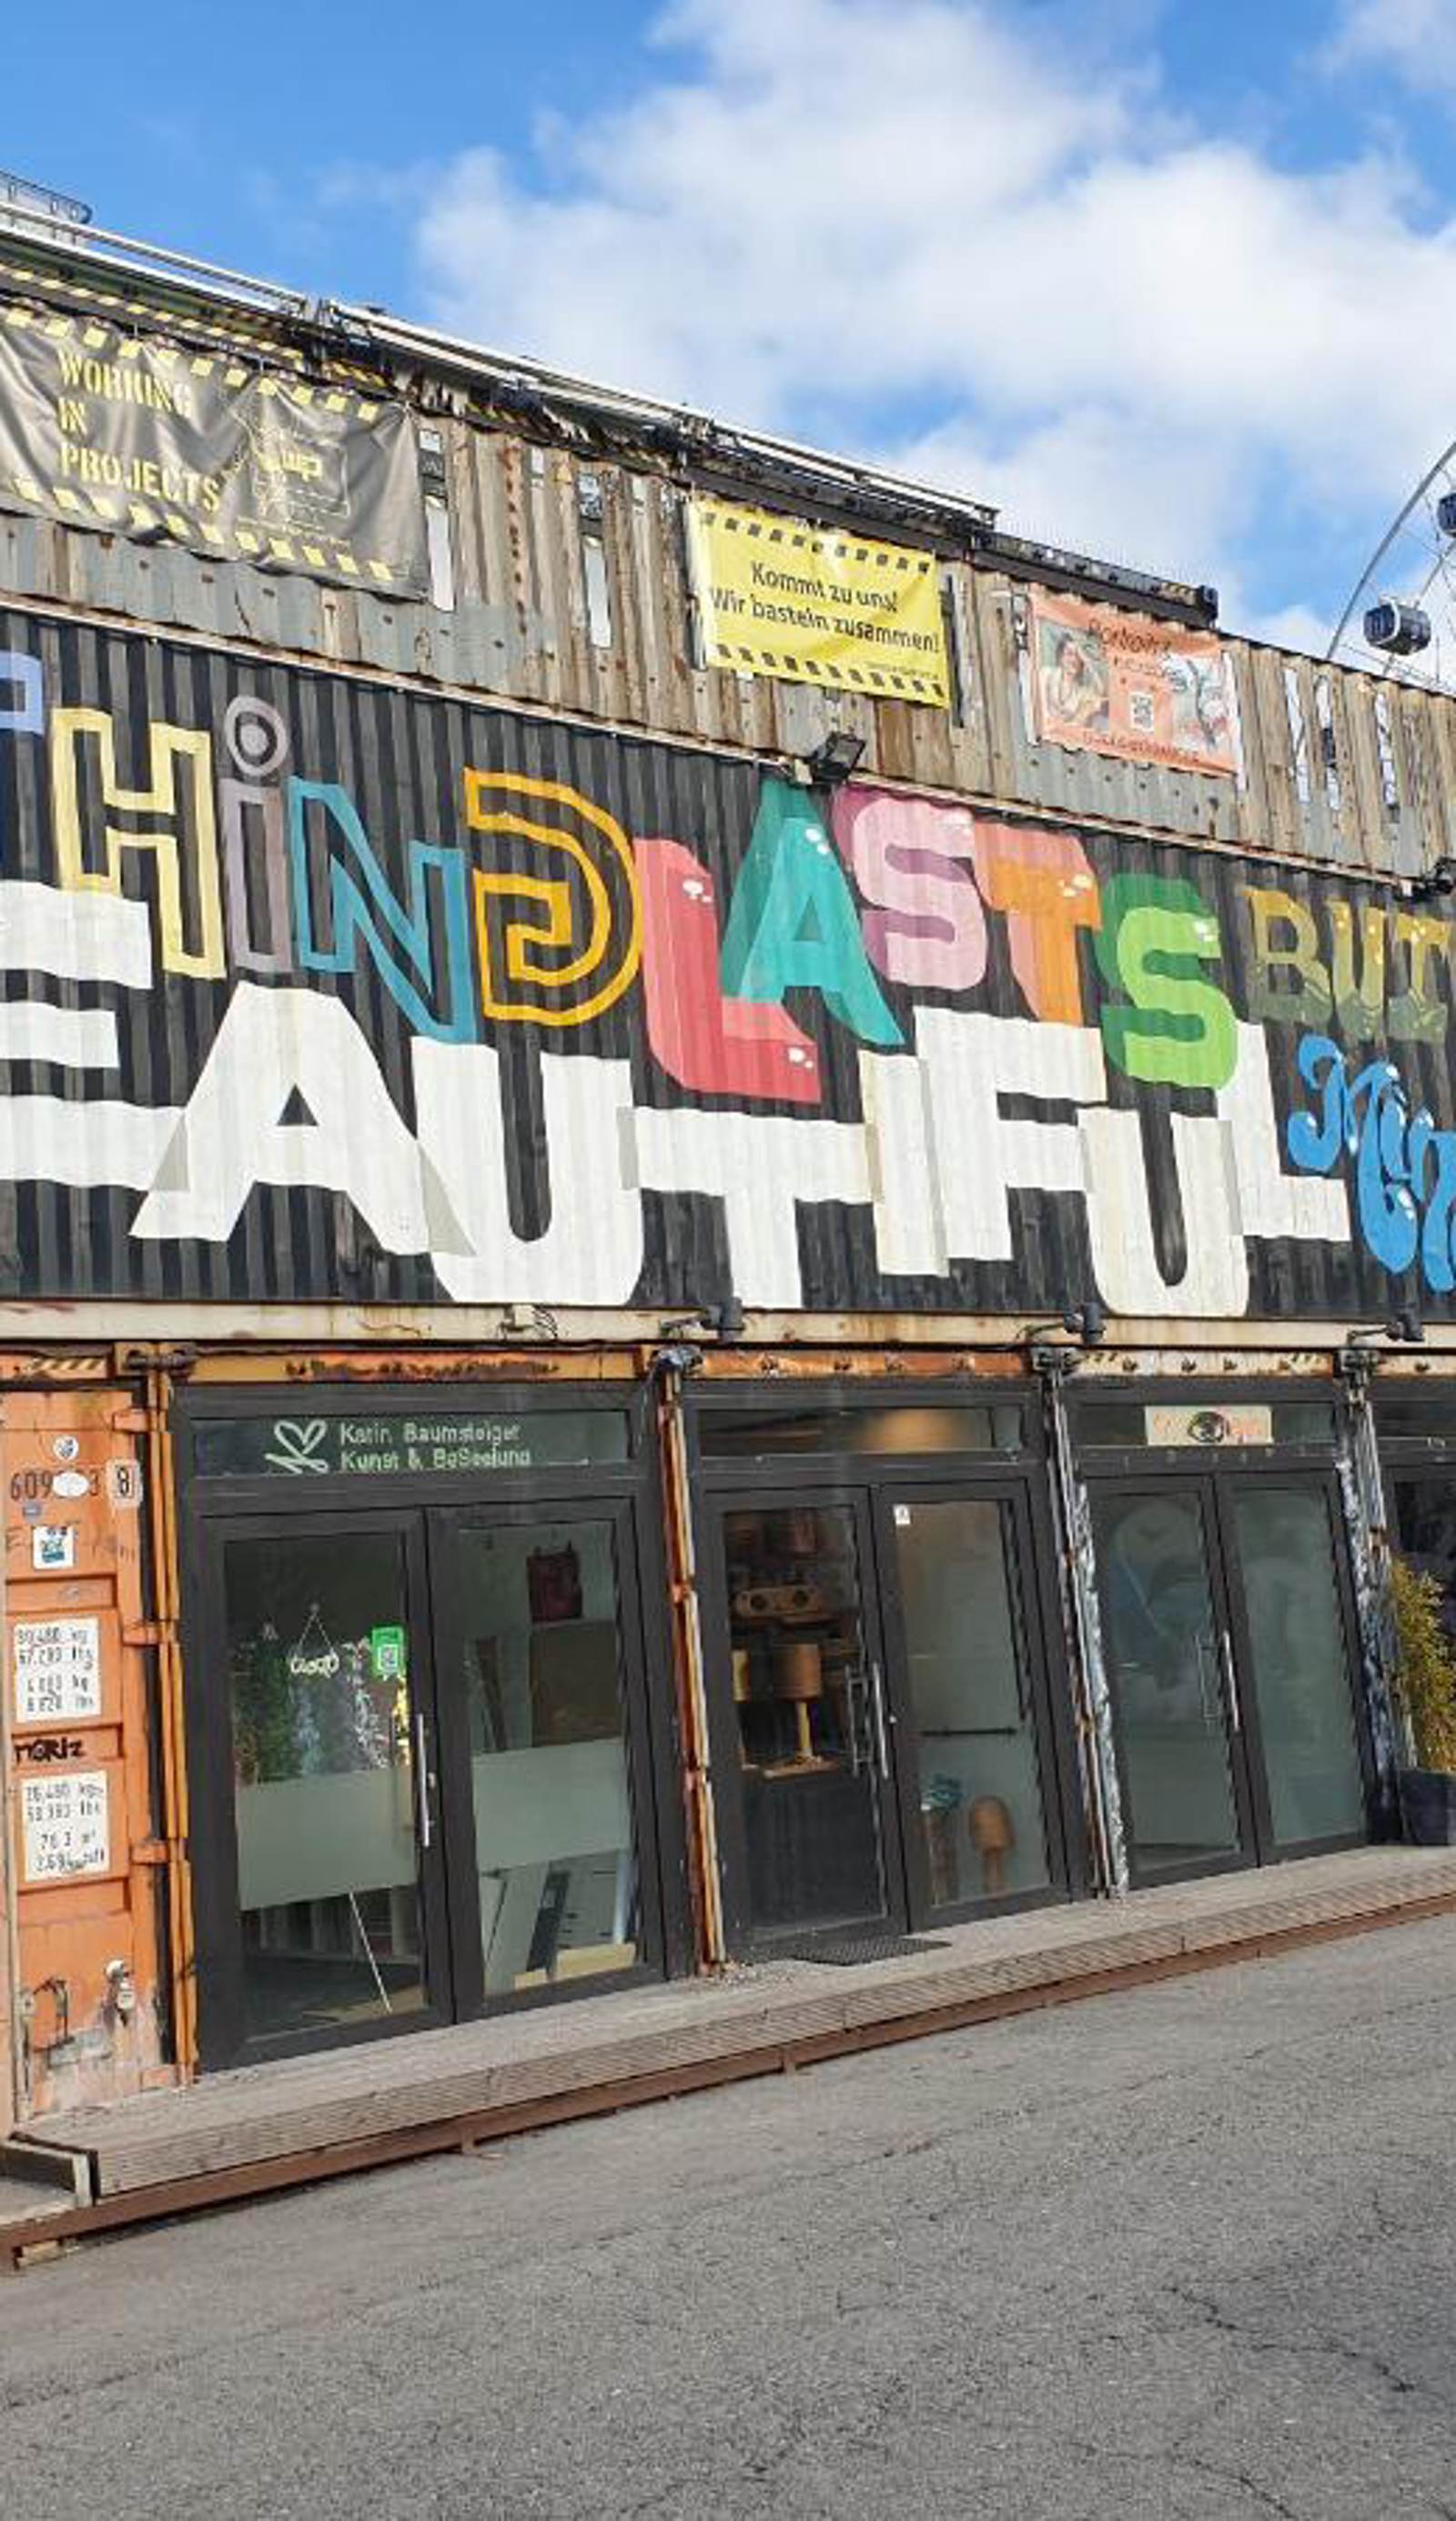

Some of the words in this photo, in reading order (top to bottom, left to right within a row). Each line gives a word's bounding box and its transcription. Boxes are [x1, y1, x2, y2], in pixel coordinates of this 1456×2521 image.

[57, 348, 194, 419] WORKING
[57, 397, 88, 435] IN
[60, 441, 220, 512] PROJECTS
[751, 561, 825, 600] Kommt
[828, 583, 854, 606] zu
[856, 590, 898, 614] uns!
[709, 587, 746, 613] Wir
[750, 593, 829, 632] basteln
[834, 619, 941, 653] zusammen!
[634, 777, 1238, 1103] LASTS
[1240, 886, 1452, 1044] BUT
[339, 1422, 392, 1445] Karin
[10, 1469, 99, 1501] 6093
[340, 1451, 399, 1473] Kunst
